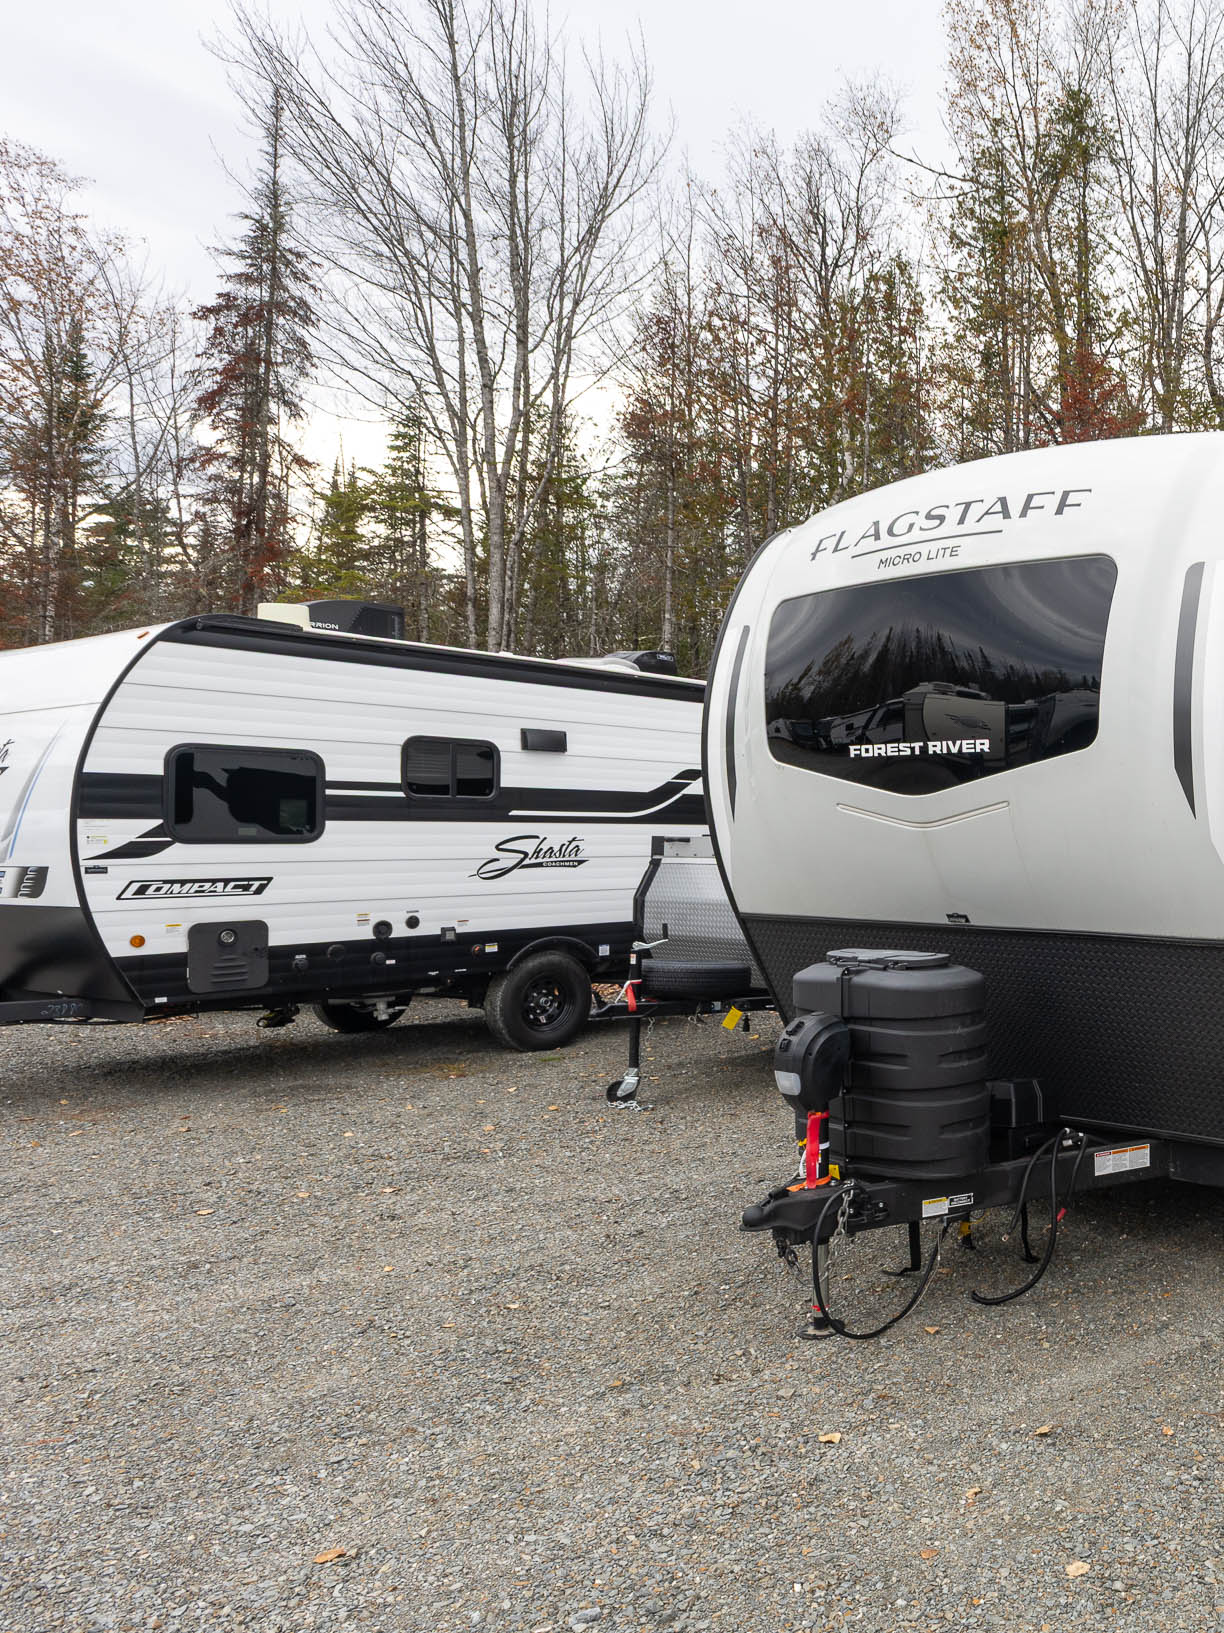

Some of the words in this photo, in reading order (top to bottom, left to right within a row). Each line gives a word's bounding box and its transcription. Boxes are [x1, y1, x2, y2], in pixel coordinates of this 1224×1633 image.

[810, 488, 1093, 562] FLAGSTAFF
[877, 551, 922, 570] MICRO
[926, 545, 961, 561] LITE
[848, 742, 924, 758] FOREST
[927, 738, 991, 755] RIVER
[476, 834, 585, 880] Shasta
[119, 880, 268, 900] COMPACT
